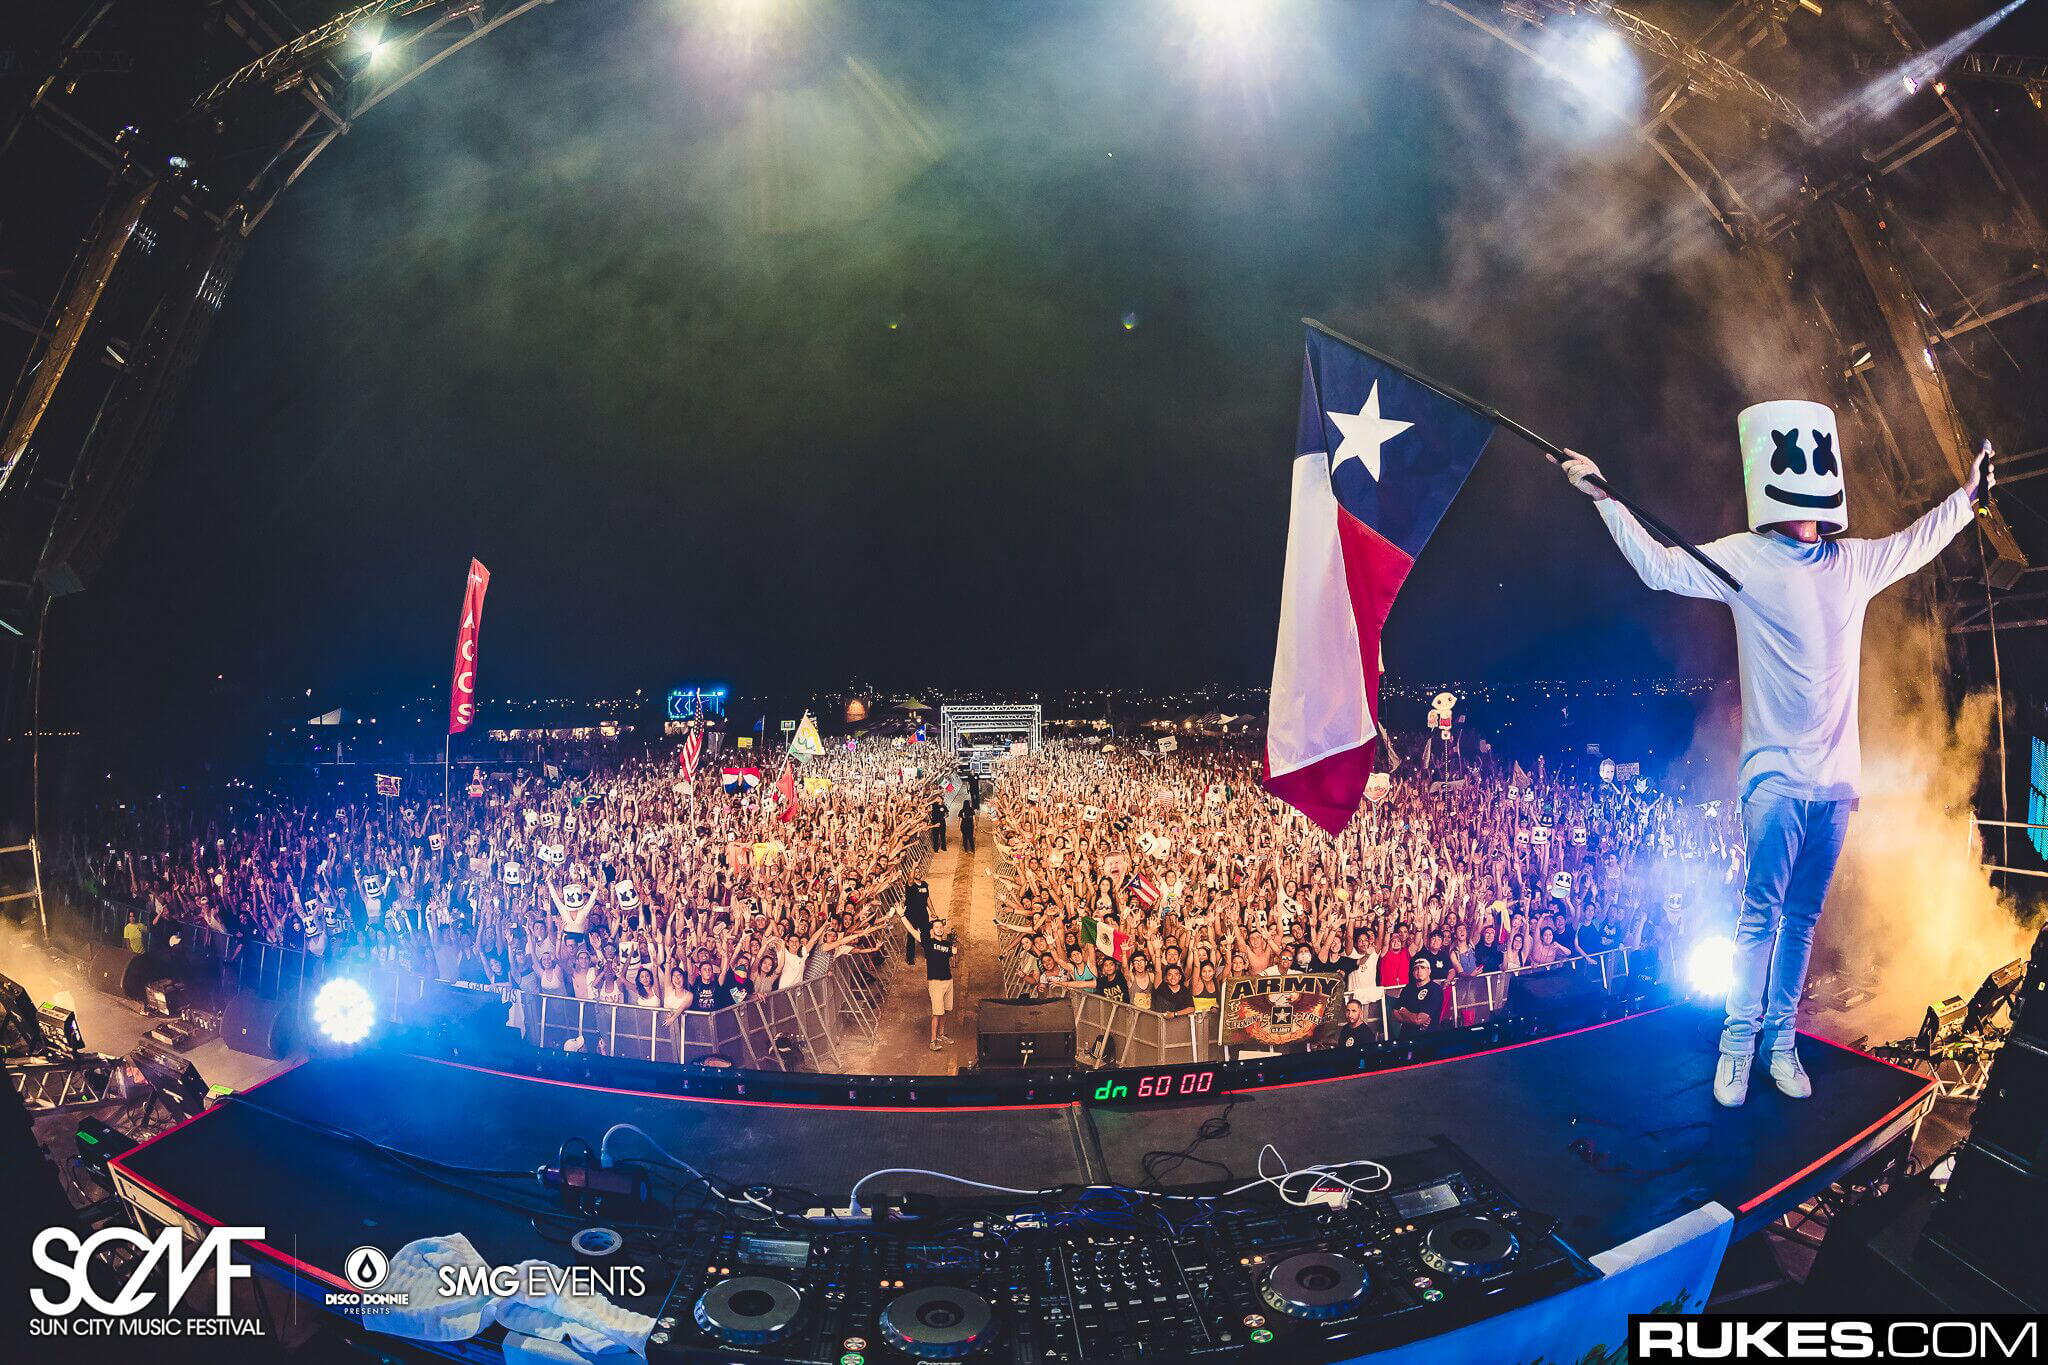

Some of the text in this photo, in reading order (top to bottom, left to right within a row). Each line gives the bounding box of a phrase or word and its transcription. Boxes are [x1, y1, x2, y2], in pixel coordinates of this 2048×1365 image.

[1103, 984, 1122, 998] SUN
[1231, 975, 1341, 1000] ARMY
[1137, 1075, 1172, 1098] 60
[1179, 1071, 1214, 1094] 00
